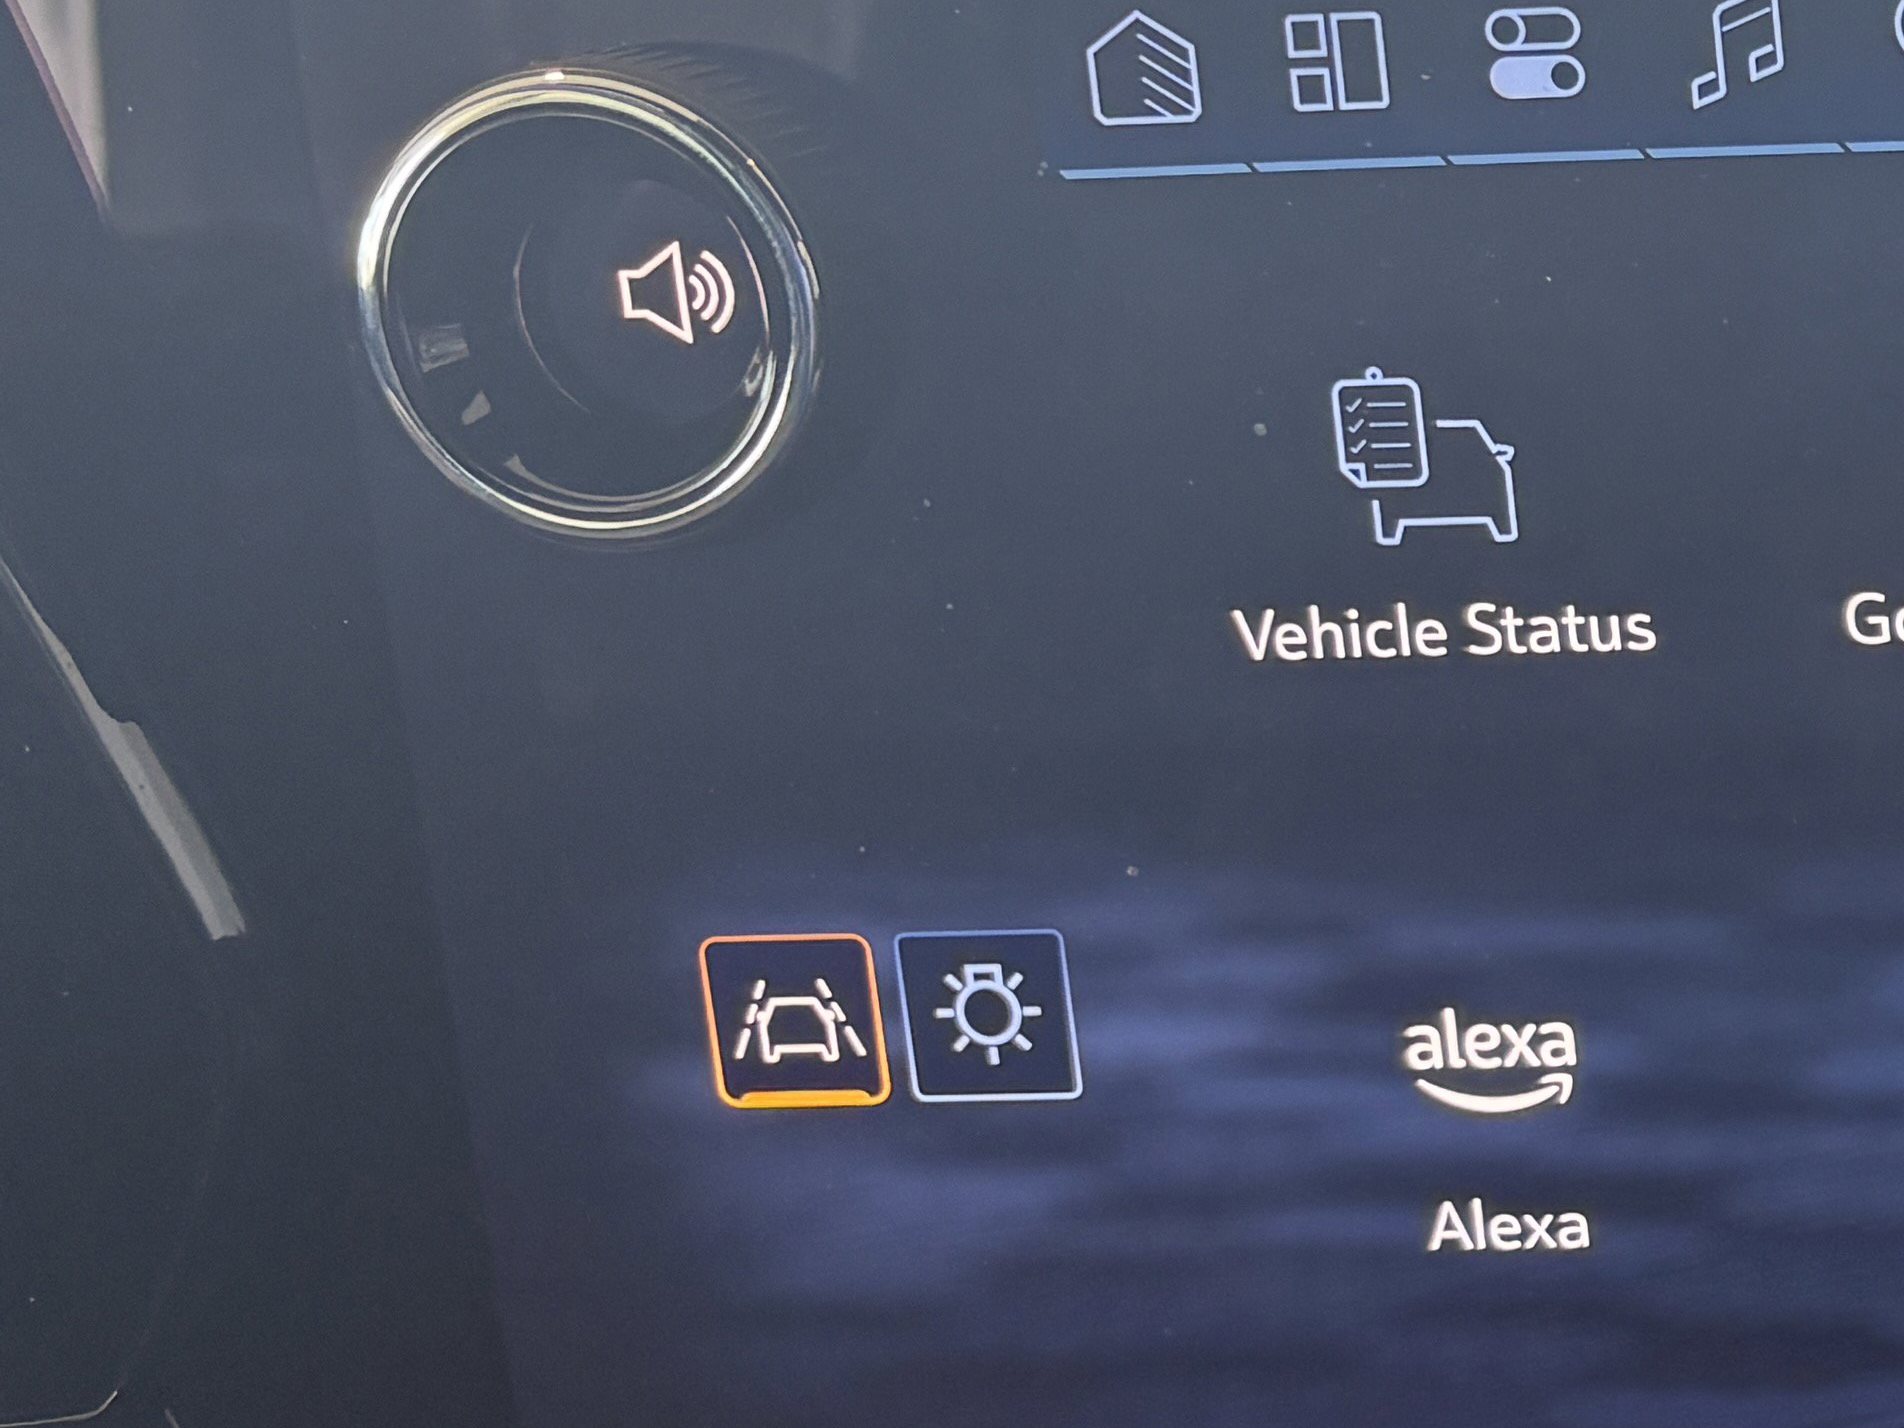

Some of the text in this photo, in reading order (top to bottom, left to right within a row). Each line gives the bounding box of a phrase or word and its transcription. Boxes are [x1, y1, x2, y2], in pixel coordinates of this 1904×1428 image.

[1232, 602, 1656, 660] Vehicle Status
[1404, 1008, 1576, 1070] alexa
[1428, 1198, 1589, 1250] Alexa
